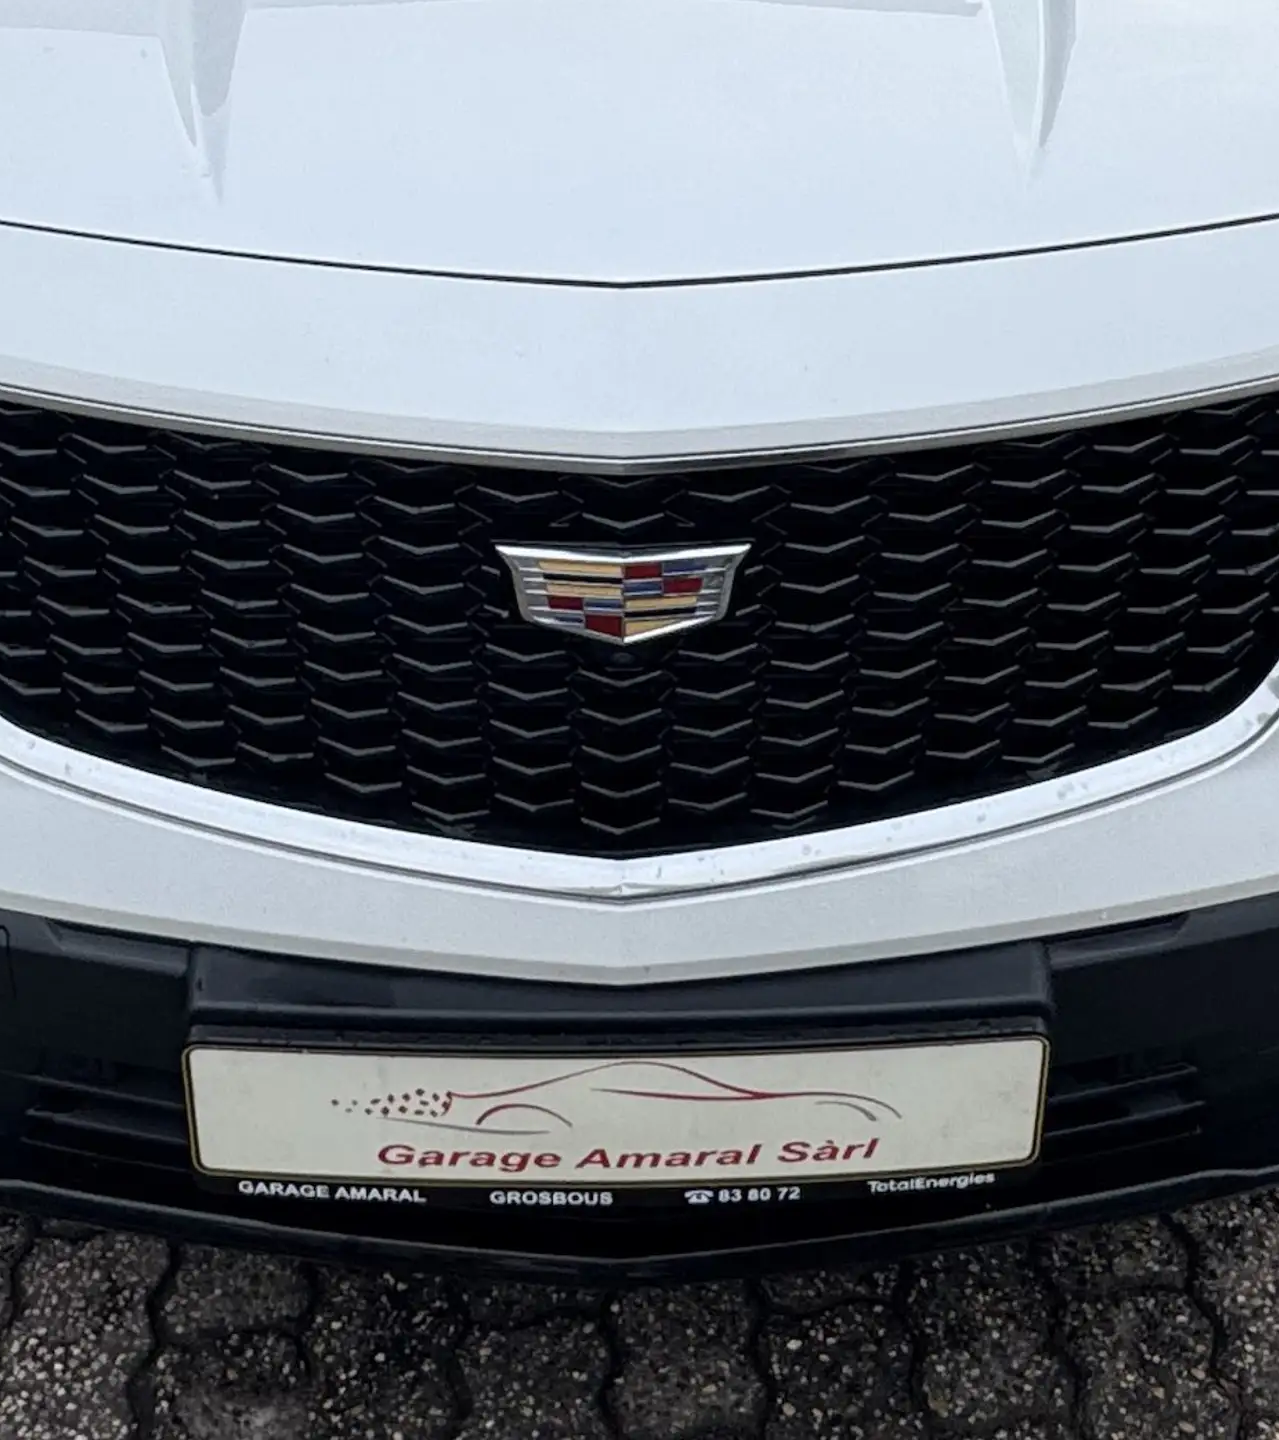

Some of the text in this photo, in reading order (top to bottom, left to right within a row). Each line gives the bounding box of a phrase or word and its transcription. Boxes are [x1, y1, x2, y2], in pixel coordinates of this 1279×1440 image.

[377, 1137, 881, 1173] Garage Amaral Sàrl
[239, 1180, 427, 1203] GARAGE AMARAL
[866, 1171, 996, 1194] TotalEnergies
[489, 1190, 613, 1206] GROSBOUS
[718, 1186, 801, 1203] 83 80 72
